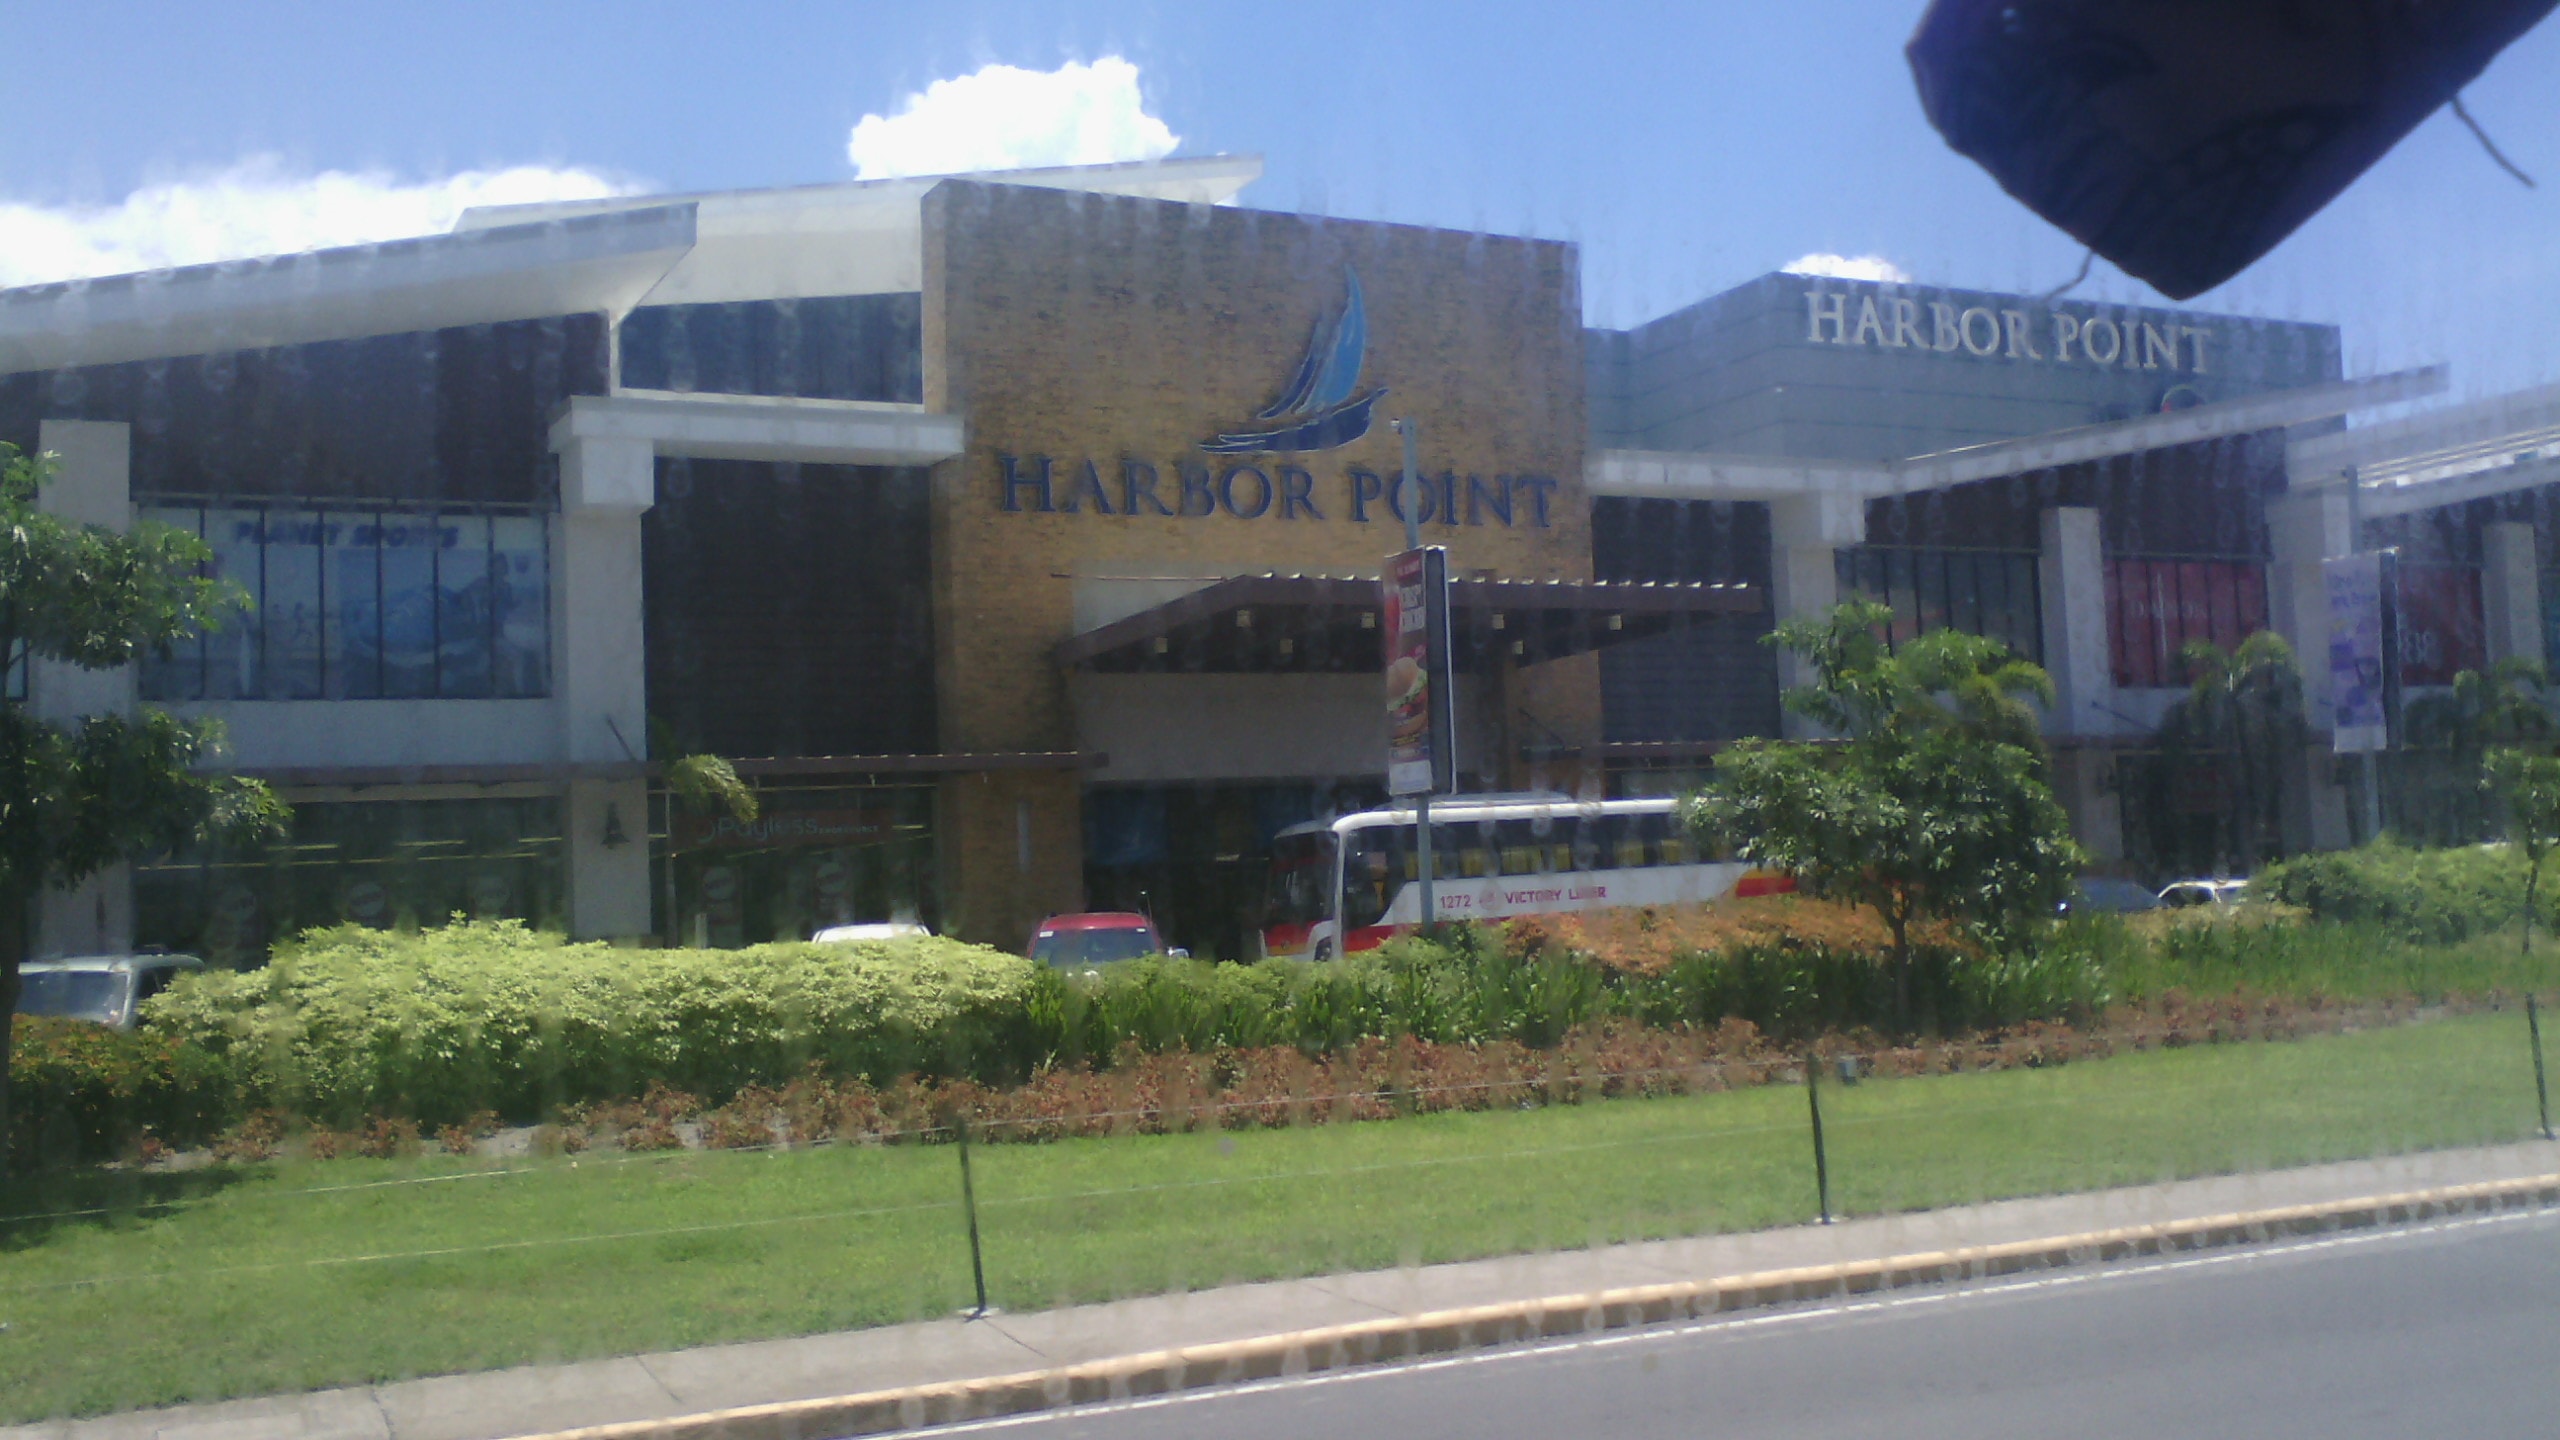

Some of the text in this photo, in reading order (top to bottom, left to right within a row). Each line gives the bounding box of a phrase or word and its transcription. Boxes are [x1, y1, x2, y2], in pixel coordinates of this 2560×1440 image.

[1804, 291, 2212, 373] HARBOR POINT
[1000, 456, 1557, 528] HARBOR POINT
[1440, 895, 1472, 908] 1272
[1568, 887, 1607, 900] LIR
